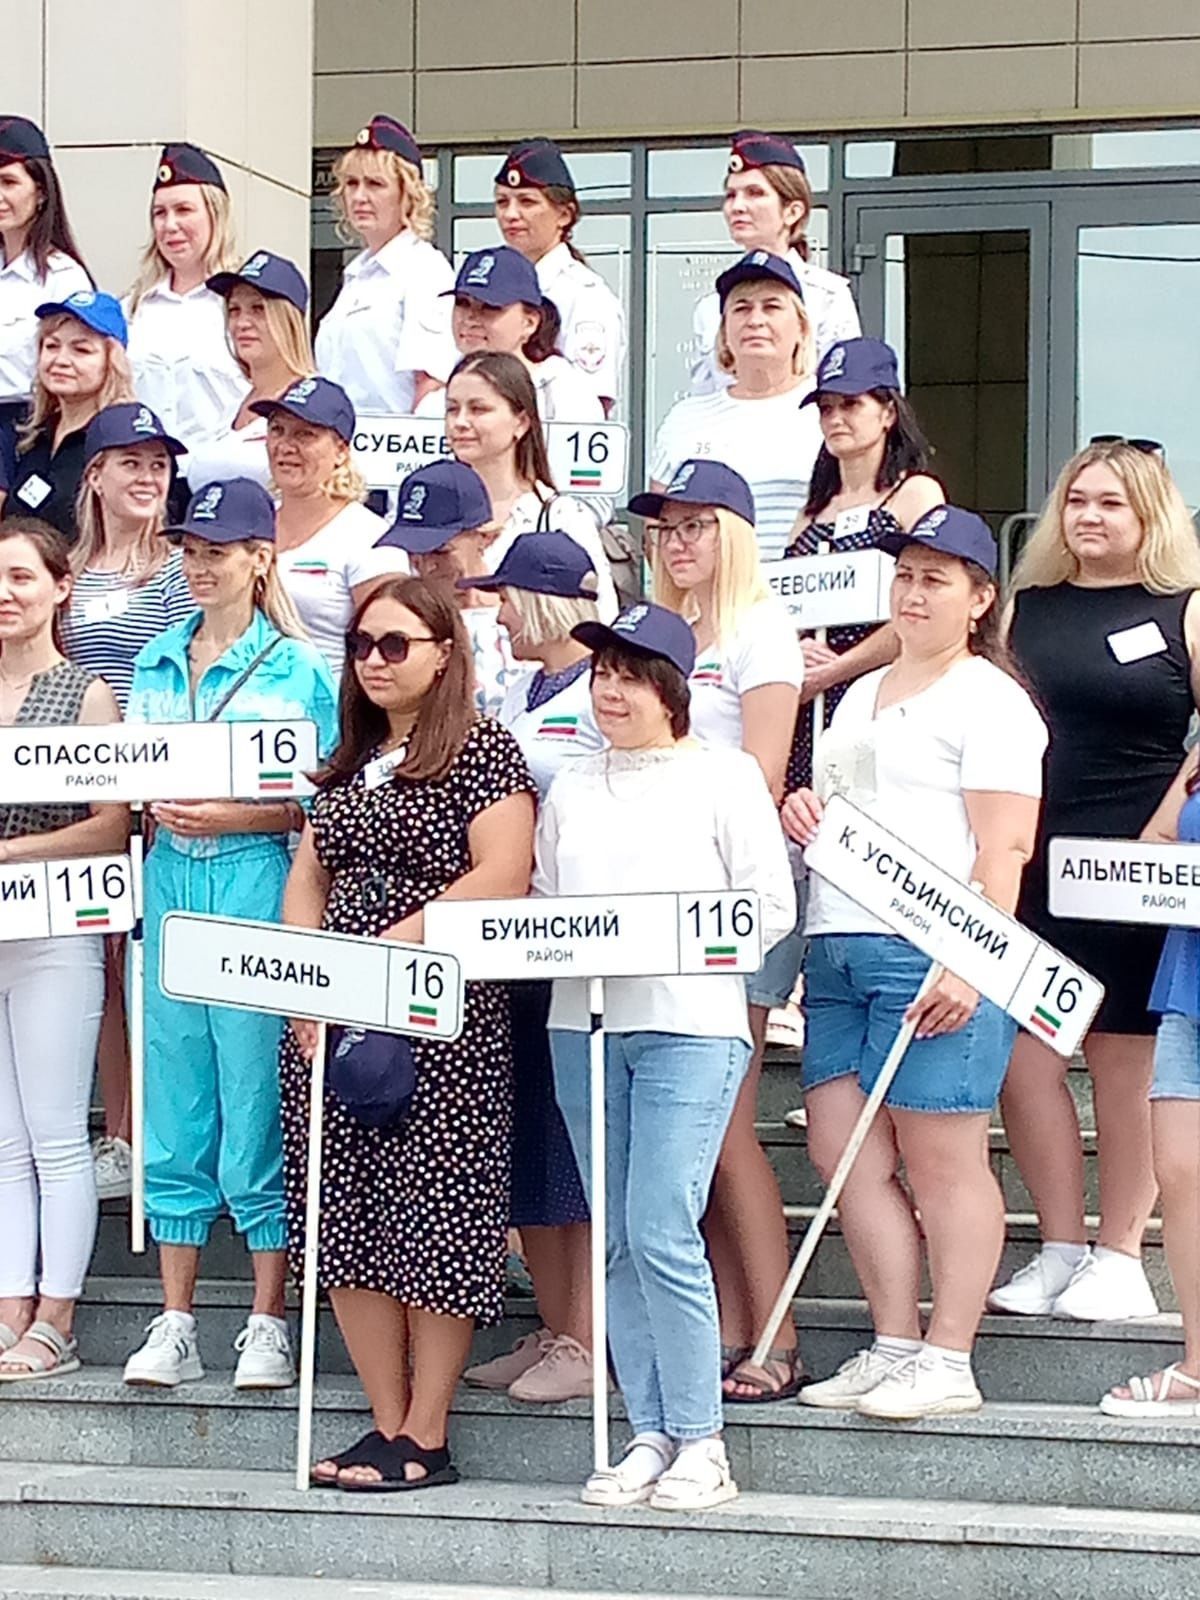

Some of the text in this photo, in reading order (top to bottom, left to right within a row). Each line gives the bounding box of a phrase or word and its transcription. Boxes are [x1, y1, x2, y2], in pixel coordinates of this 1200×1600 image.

[566, 431, 609, 463] 16
[14, 737, 170, 766] СПАССКИЙ
[250, 728, 298, 765] 16
[65, 773, 118, 787] РАЙОН
[56, 863, 126, 902] 116
[838, 825, 1009, 961] К. УСТЬИНСКИЙ
[687, 898, 754, 938] 116
[889, 897, 932, 936] РАЙОН
[1141, 893, 1187, 909] РАЙОН
[481, 909, 620, 941] БУИНСКИЙ
[221, 954, 331, 988] г. КАЗАНЬ
[527, 947, 574, 963] РАЙОН
[404, 958, 445, 1000] 16
[1041, 964, 1084, 1014] 16
